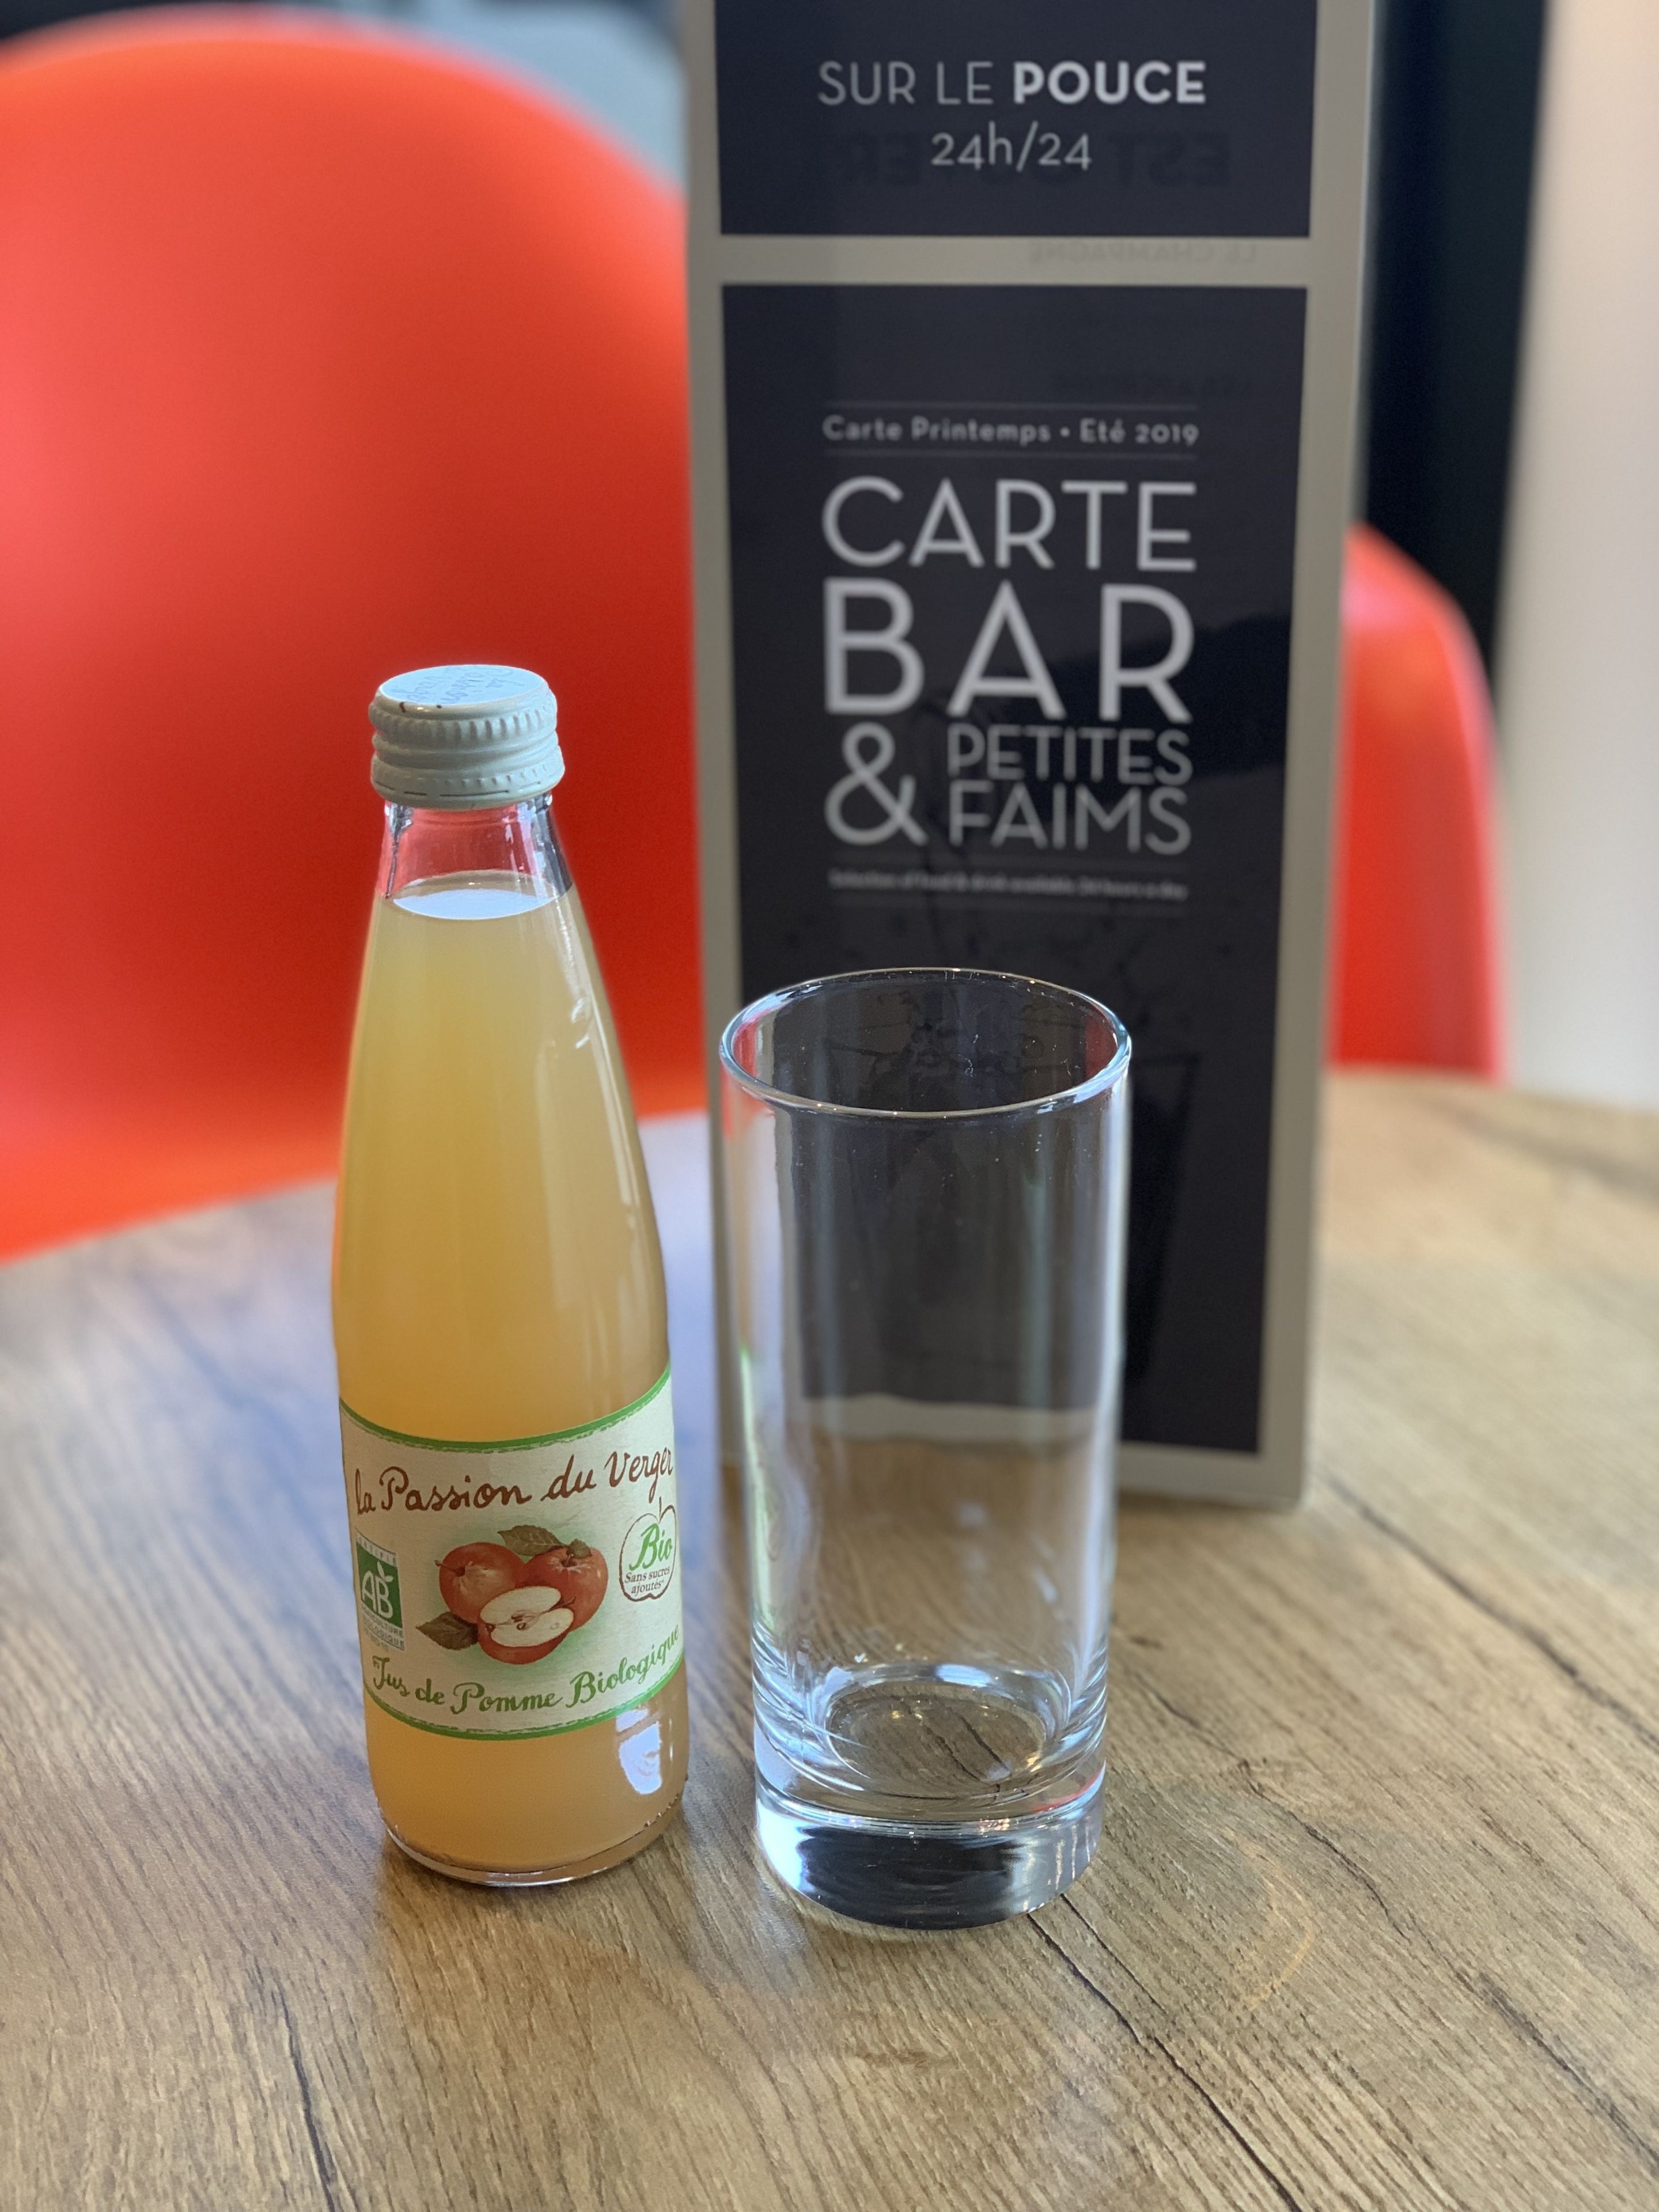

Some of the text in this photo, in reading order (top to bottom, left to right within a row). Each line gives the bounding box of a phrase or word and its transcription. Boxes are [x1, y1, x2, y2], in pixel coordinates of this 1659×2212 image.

[819, 61, 1206, 106] SUR LE POUCE
[931, 122, 1092, 172] 24h/24
[823, 415, 1200, 447] Carte Printemps Eté 2019
[821, 475, 1196, 573] CARTE
[824, 577, 1195, 724] BAR
[825, 721, 1194, 846] & PETITES
[949, 779, 1192, 855] FAIMS
[355, 1447, 673, 1515] la Passion du Verger
[625, 1566, 671, 1584] Sans sucres
[629, 1523, 673, 1571] Bio
[362, 1570, 393, 1618] AB
[372, 1624, 680, 1715] Jus de Pomme Biologique
